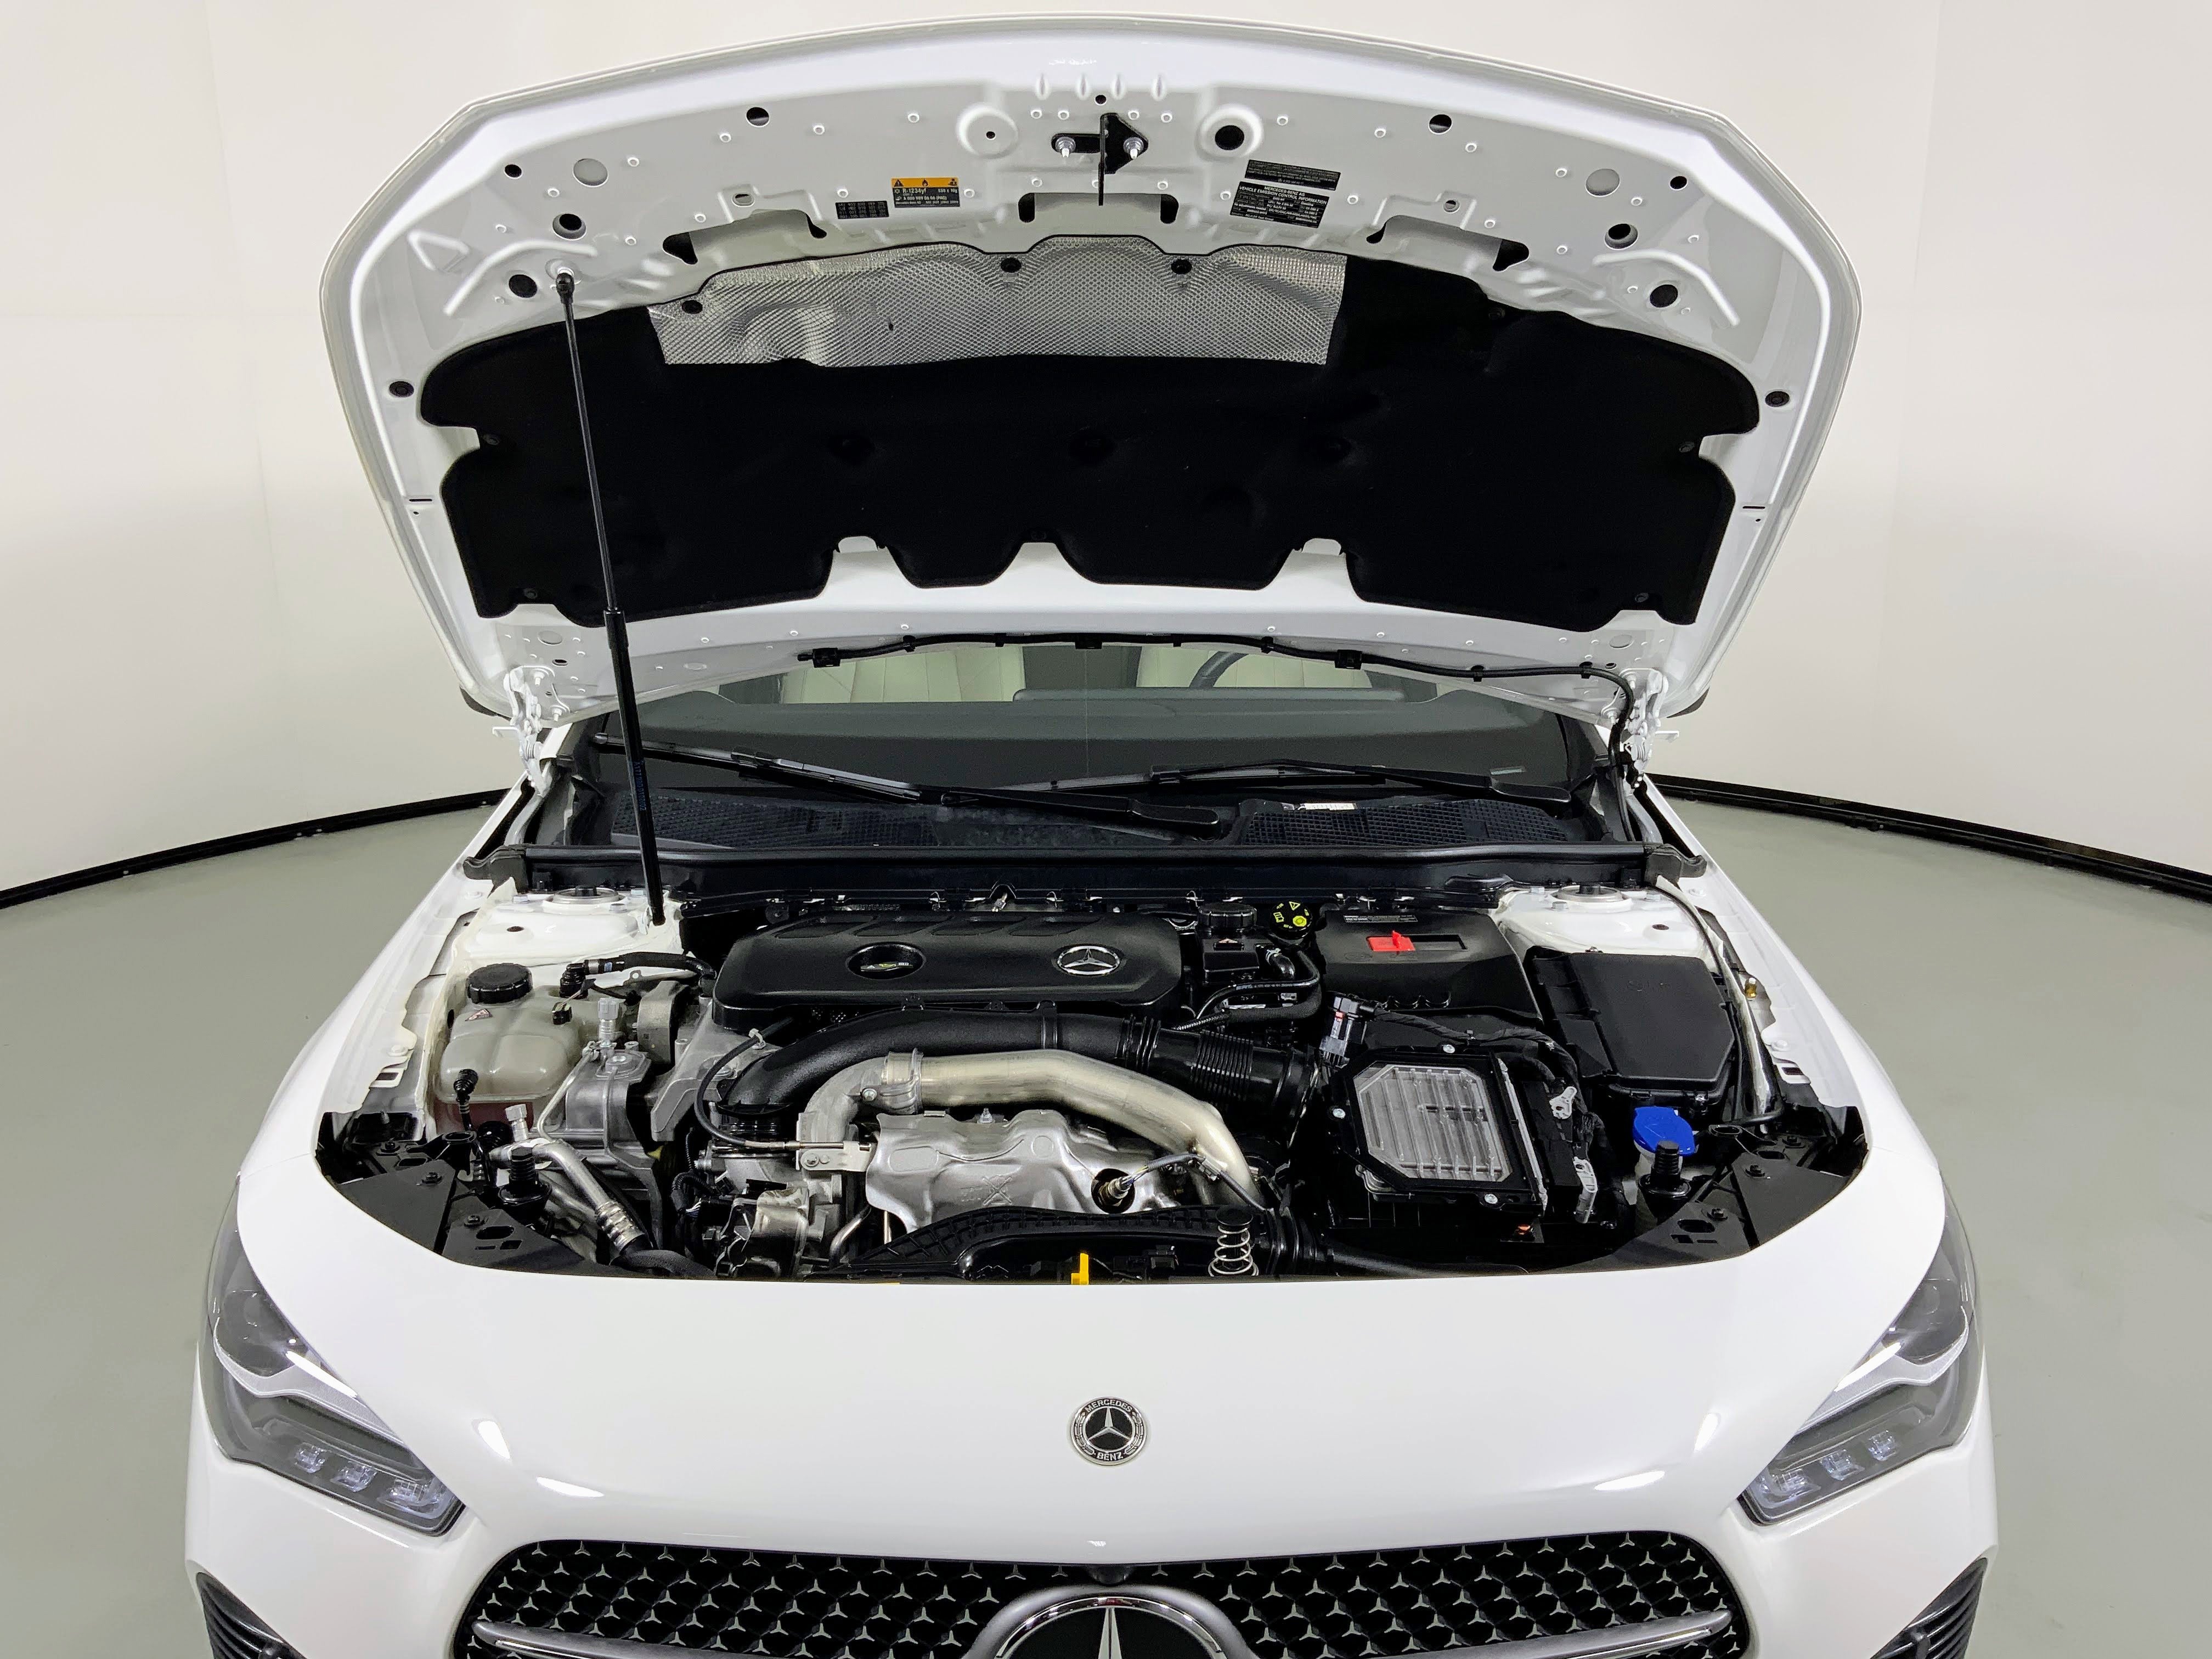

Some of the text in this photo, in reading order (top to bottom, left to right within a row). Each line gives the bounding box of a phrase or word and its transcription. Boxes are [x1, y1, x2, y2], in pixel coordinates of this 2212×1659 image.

[1298, 196, 1327, 205] INFORMATION
[1085, 1399, 1132, 1412] MERCEDES
[1097, 1452, 1124, 1461] BENZ
